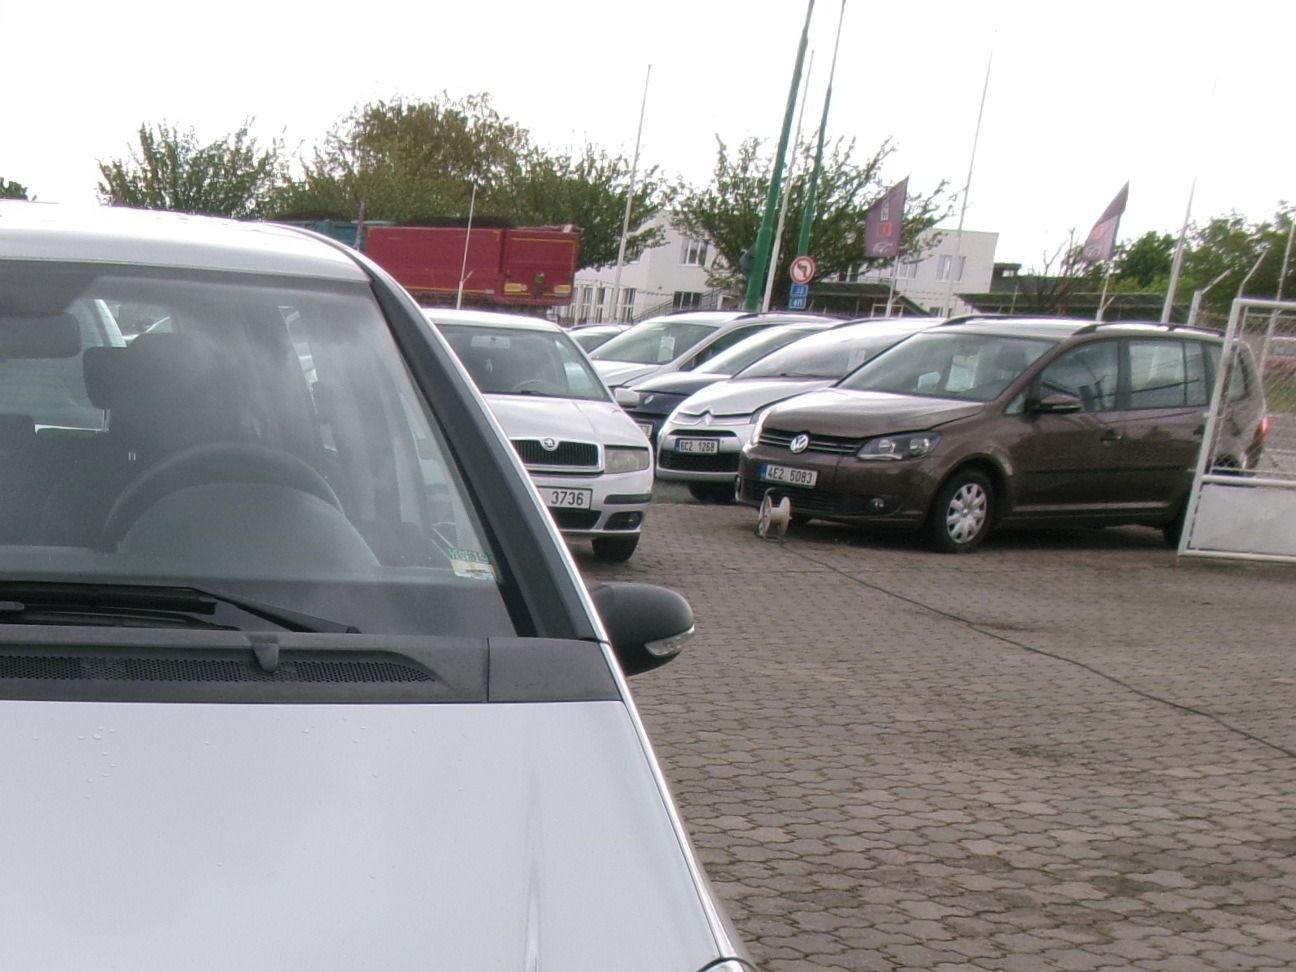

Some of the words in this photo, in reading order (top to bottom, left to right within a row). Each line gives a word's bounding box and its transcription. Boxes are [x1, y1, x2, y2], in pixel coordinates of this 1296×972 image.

[767, 466, 784, 480] 4E2
[790, 469, 813, 484] 5083
[551, 491, 584, 506] 3736
